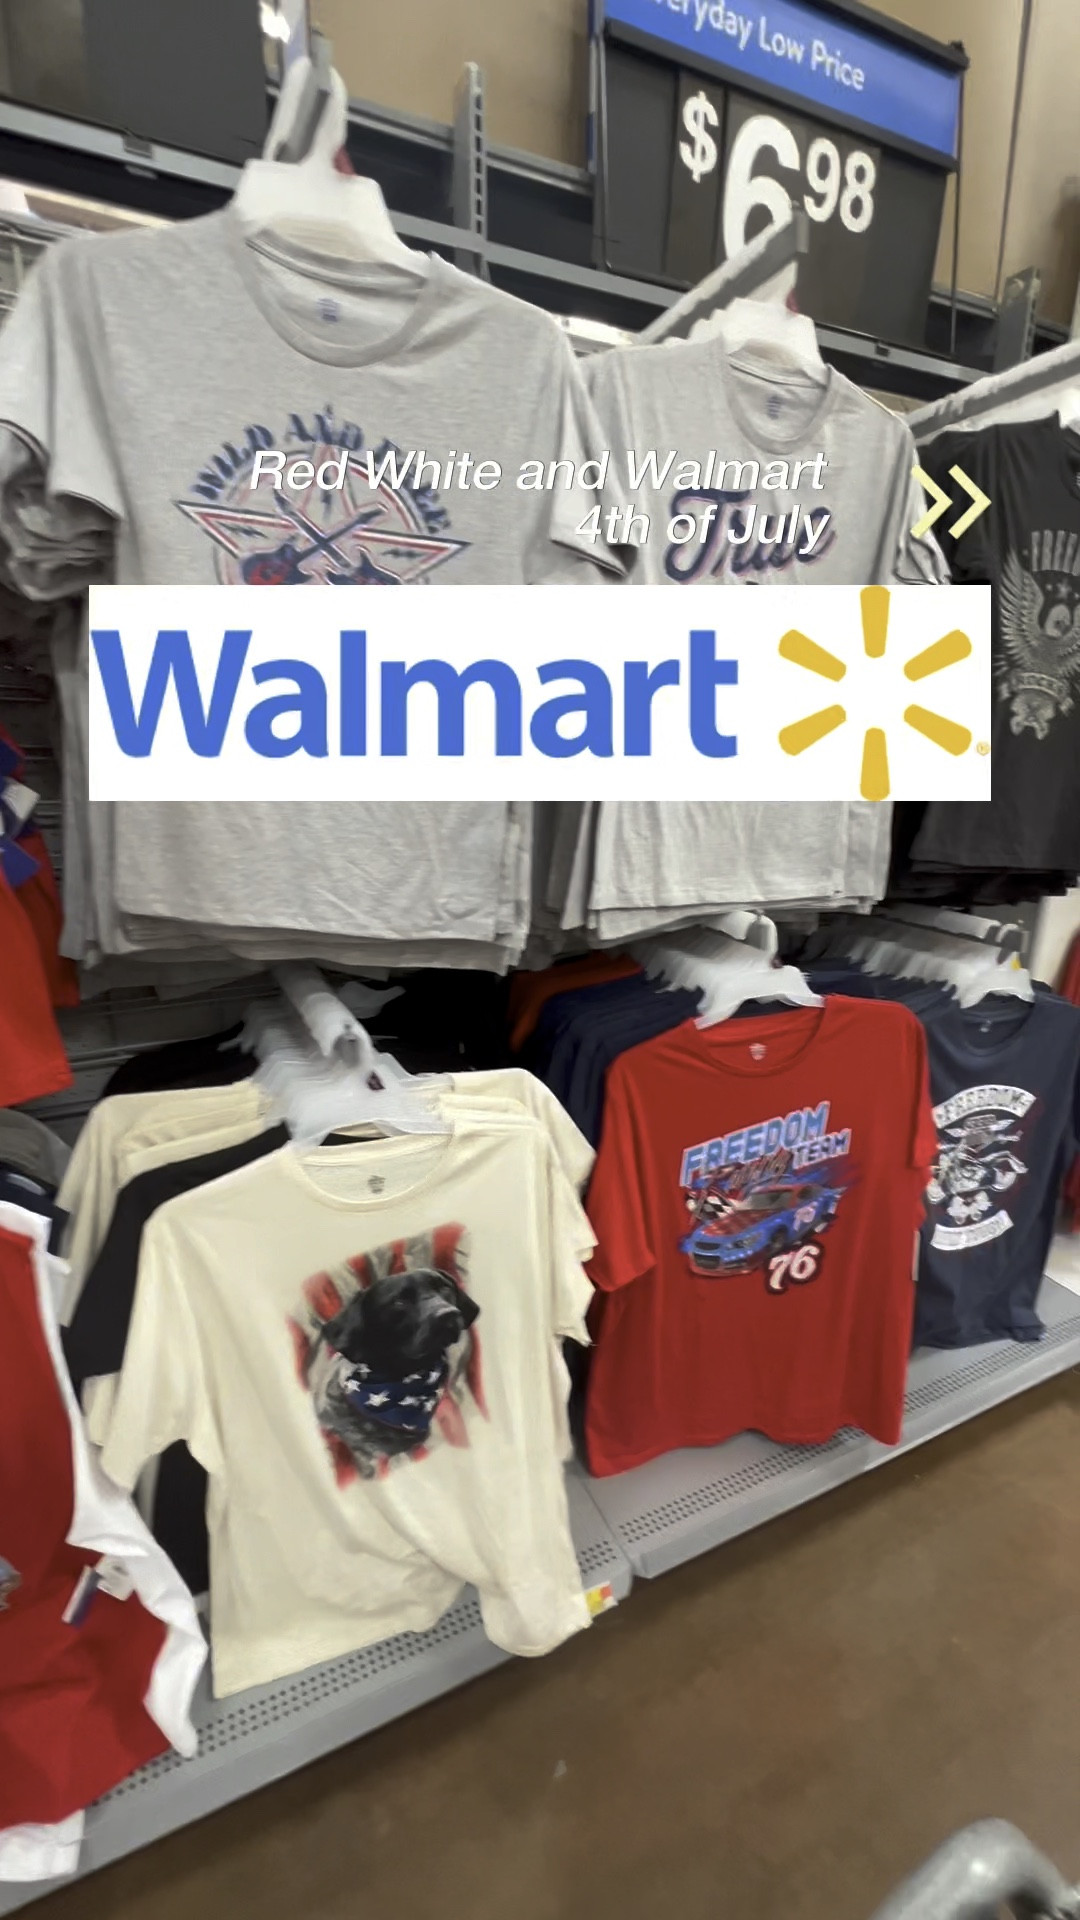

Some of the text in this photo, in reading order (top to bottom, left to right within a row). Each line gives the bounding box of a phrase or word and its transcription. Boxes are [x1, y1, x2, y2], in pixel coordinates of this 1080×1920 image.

[759, 15, 805, 64] Low
[811, 38, 865, 91] Price
[680, 1101, 831, 1187] FREEDOM
[792, 1128, 851, 1170] TEAM
[768, 1245, 820, 1290] 76
